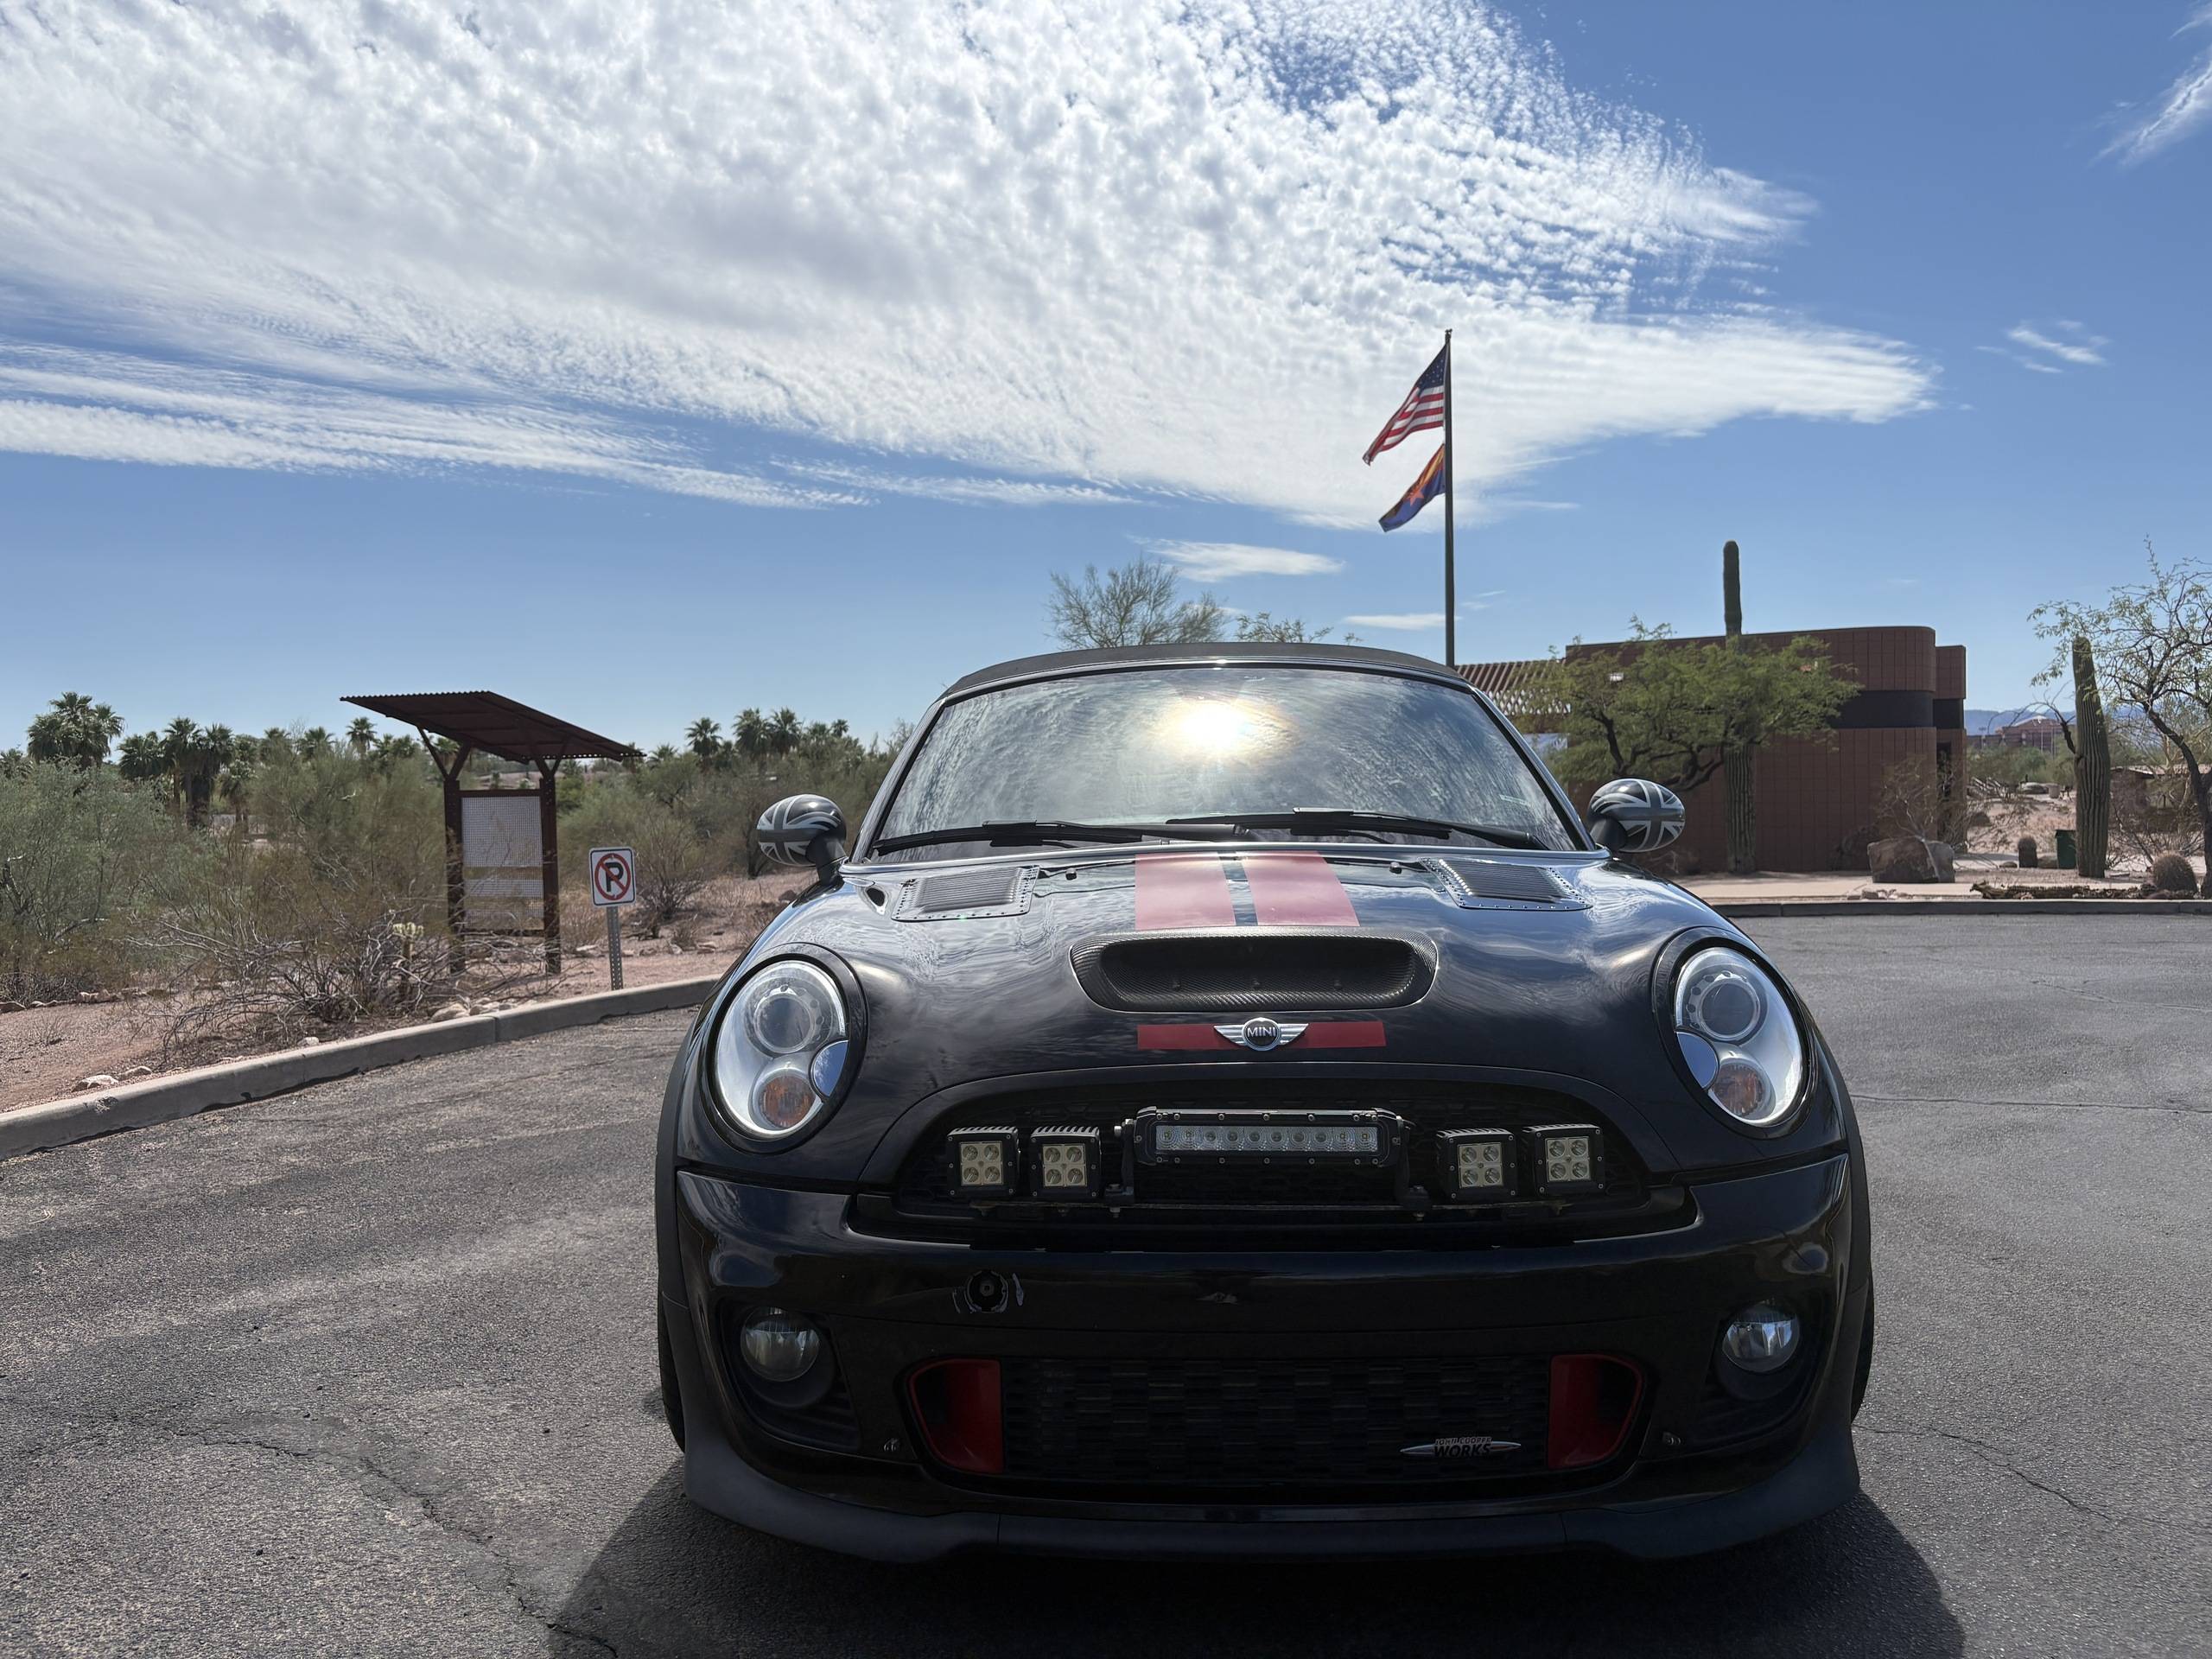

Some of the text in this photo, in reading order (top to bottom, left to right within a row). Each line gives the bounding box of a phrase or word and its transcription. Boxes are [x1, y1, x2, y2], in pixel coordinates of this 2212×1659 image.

[605, 861, 624, 892] P
[1247, 1027, 1276, 1038] MINI
[1434, 1443, 1491, 1458] WORKS
